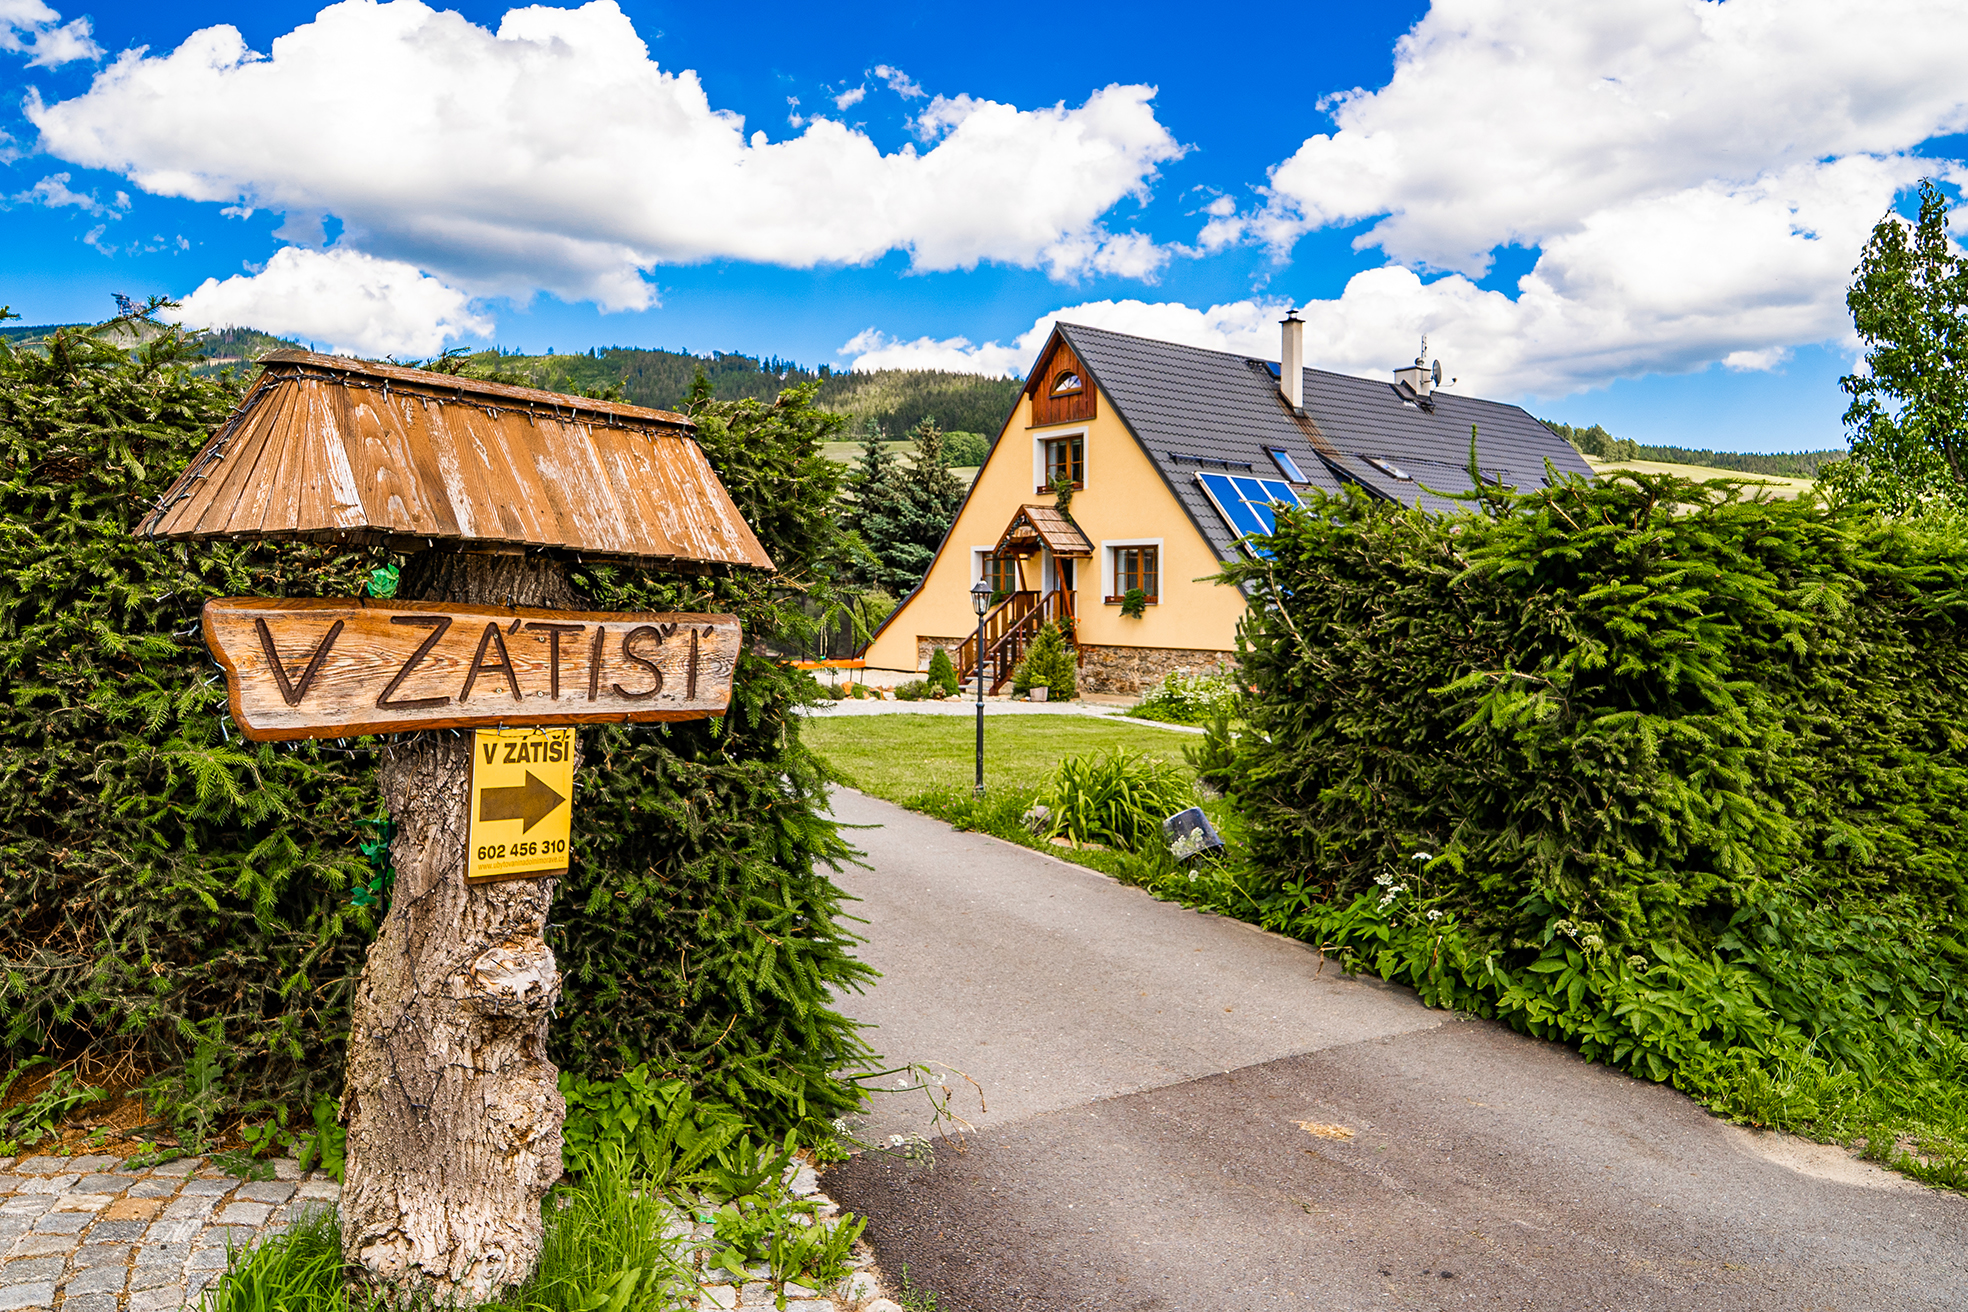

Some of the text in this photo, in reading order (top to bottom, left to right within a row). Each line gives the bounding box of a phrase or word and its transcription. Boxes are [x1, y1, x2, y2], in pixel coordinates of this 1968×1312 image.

[255, 615, 714, 710] V ZÁTIŠÍ
[483, 735, 571, 765] V ZÁTIŠÍ
[477, 839, 566, 861] 602 456 310
